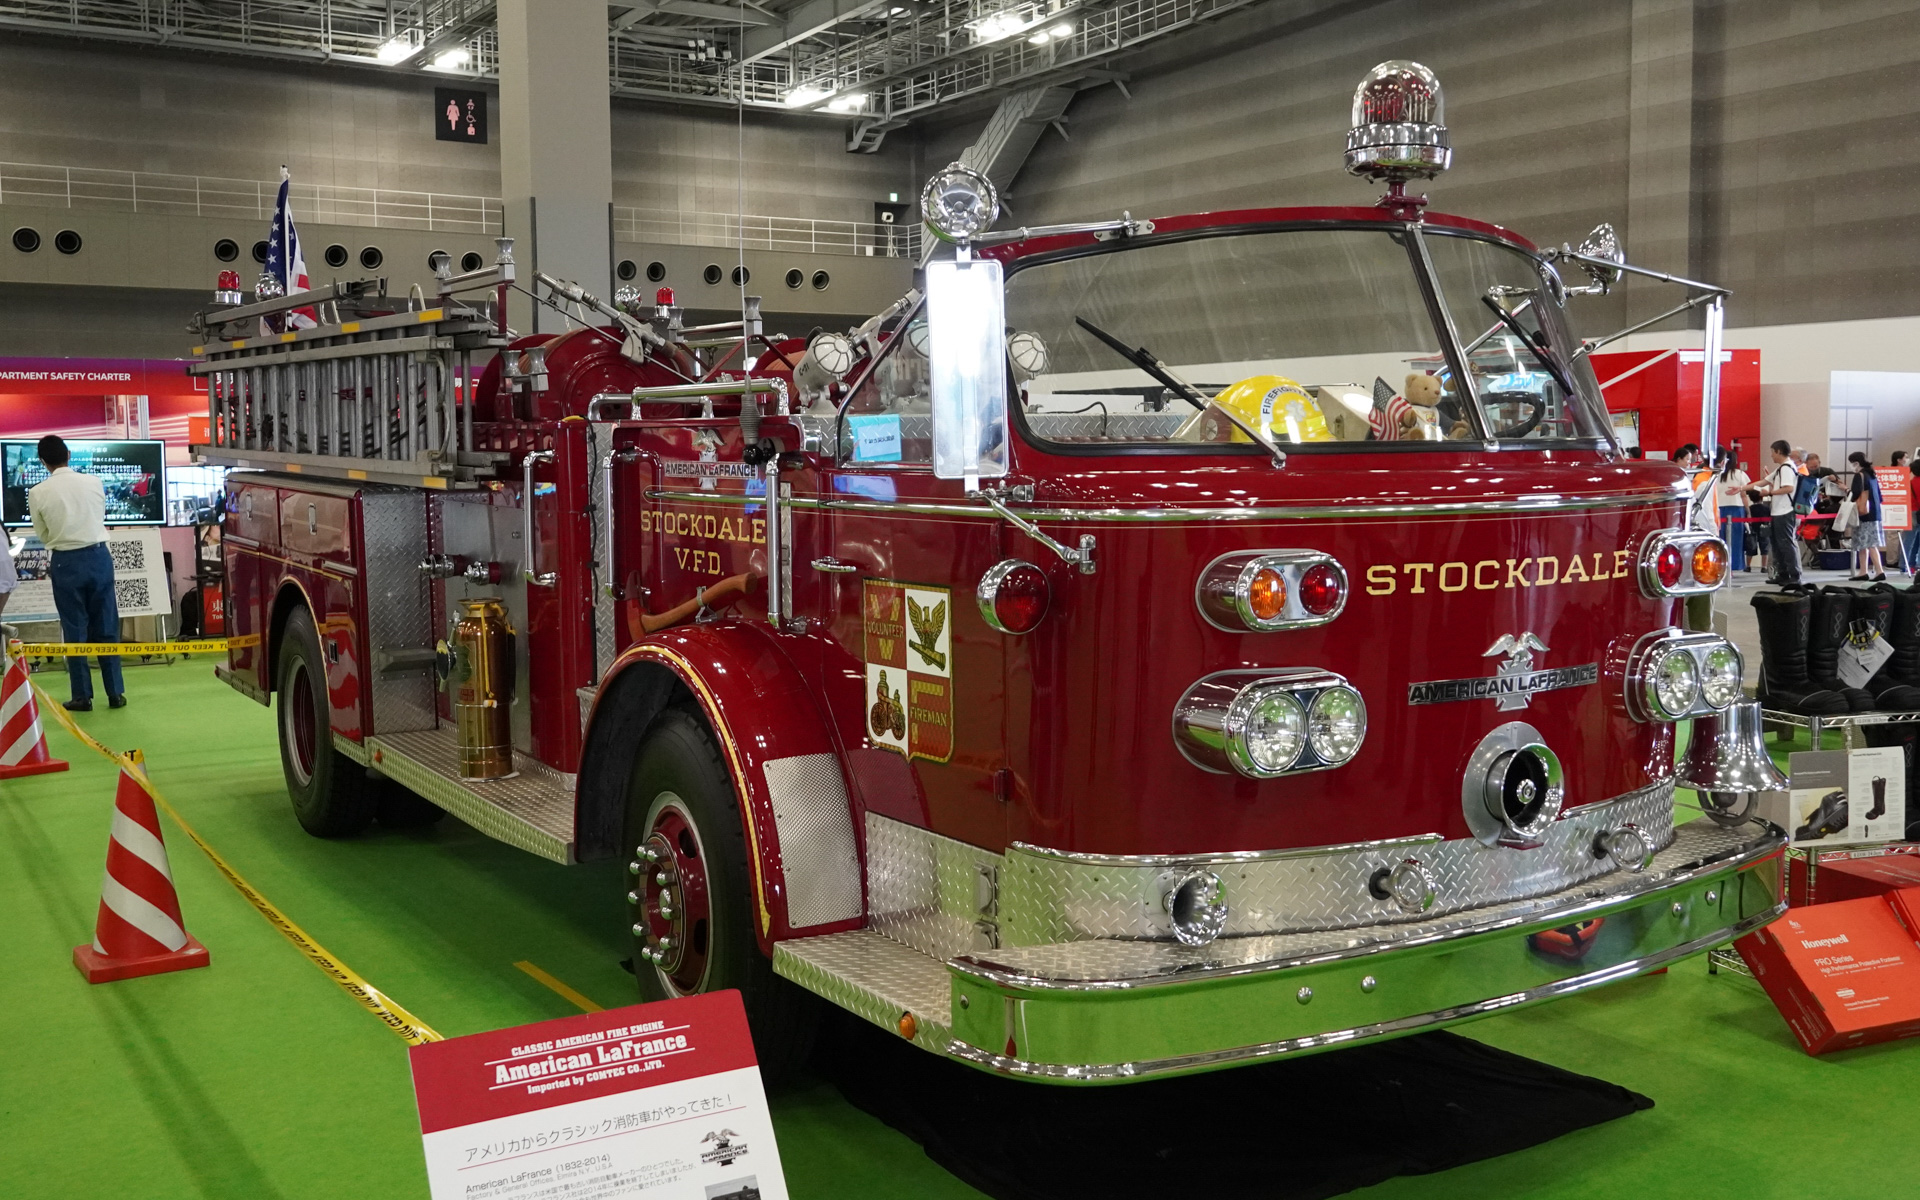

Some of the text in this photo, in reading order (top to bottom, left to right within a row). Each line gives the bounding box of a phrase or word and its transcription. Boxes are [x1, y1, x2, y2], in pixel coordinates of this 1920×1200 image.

[50, 372, 85, 381] SAFETY
[87, 372, 131, 381] CHARTER
[665, 464, 707, 476] AMERICAN
[641, 510, 766, 544] STOCKDALE
[674, 547, 725, 576] V.F.D.
[1366, 549, 1630, 596] STOCKDALE
[867, 621, 905, 639] VOLUNTEER
[1409, 678, 1514, 702] AMERICAN
[910, 706, 947, 728] FIREMAN
[1801, 934, 1849, 950] Honeywell
[1813, 954, 1854, 967] PRO Series
[510, 1020, 665, 1057] CLASSIC AMERICAN FIRE ENGINE
[495, 1034, 688, 1084] American LaFrance
[527, 1077, 571, 1094] Imported
[572, 1075, 585, 1087] by
[586, 1068, 626, 1083] COMTEC
[464, 1094, 733, 1163] アメリカからクラシック消防車がやってきた！
[465, 1153, 611, 1194] American LaFrance (1832-2014)
[502, 1183, 529, 1193] General
